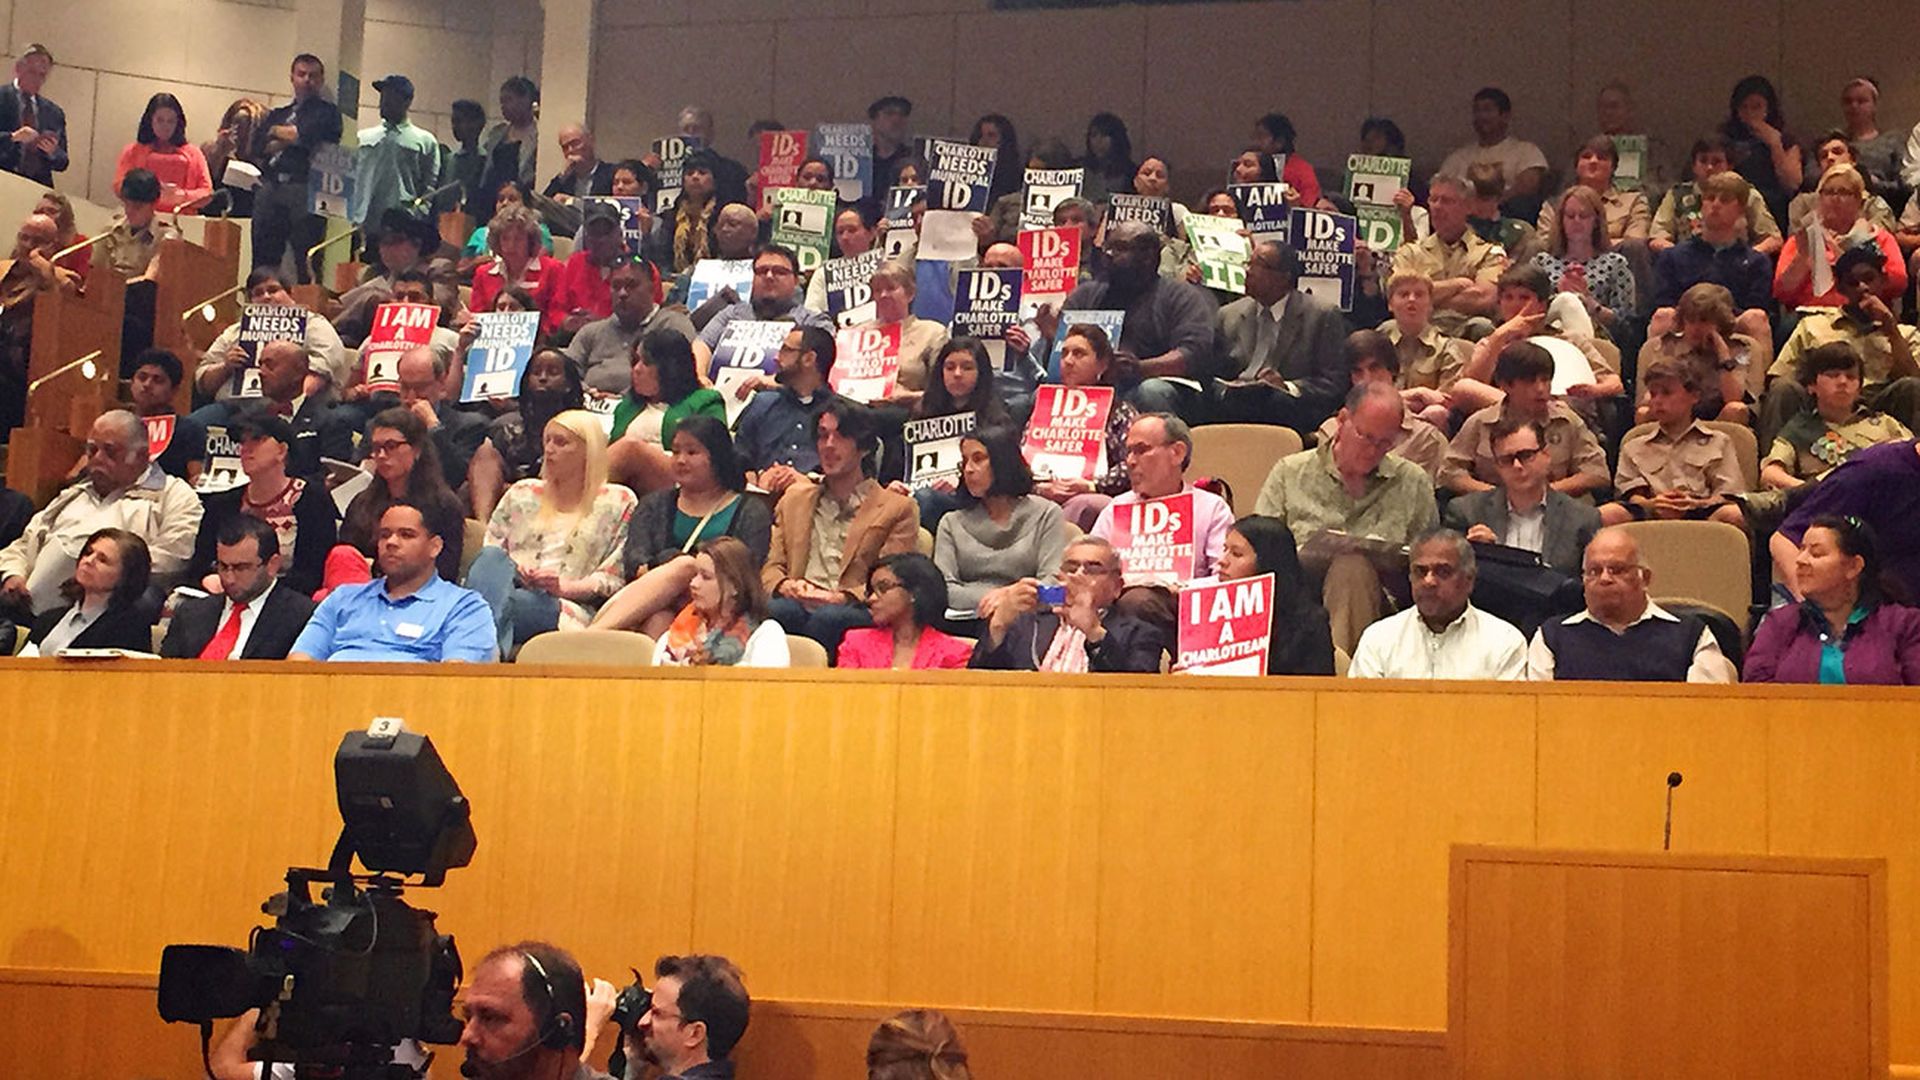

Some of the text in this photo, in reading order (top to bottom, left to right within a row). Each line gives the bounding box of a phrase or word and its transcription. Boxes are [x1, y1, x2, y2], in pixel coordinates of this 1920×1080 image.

[661, 138, 693, 160] IDs
[771, 134, 799, 156] IDs
[825, 135, 866, 147] NEEDS
[935, 142, 995, 162] CHARLOTTE
[834, 155, 858, 178] ID
[939, 155, 988, 175] NEEDS
[1348, 154, 1410, 175] CHARLOTTE
[322, 172, 344, 195] ID
[930, 169, 989, 187] MUNICIPAL
[1024, 169, 1083, 185] CHARLOTTE
[777, 187, 837, 204] CHARLOTTE
[943, 180, 972, 209] ID
[1111, 196, 1168, 211] CHARLOTTE
[1247, 184, 1283, 207] AM
[1114, 207, 1161, 224] NEEDS
[1254, 208, 1264, 220] A
[1304, 211, 1346, 242] IDs
[1358, 219, 1394, 250] D
[1032, 230, 1070, 259] IDs
[1307, 238, 1340, 252] MAKE
[826, 247, 886, 272] CHARLOTTE
[1032, 257, 1063, 269] MAKE
[1304, 262, 1339, 275] SAFER
[832, 261, 878, 283] NEEDS
[1205, 260, 1247, 294] ID
[827, 274, 873, 294] MUNICIP
[968, 271, 1012, 301] IDs
[1030, 279, 1064, 292] SAFER
[843, 284, 873, 310] ID
[970, 300, 1005, 312] MAKE
[244, 304, 307, 319] CHARLOTTE
[380, 307, 431, 330] I AM
[477, 312, 538, 325] CHARLOTTE
[955, 311, 1018, 325] CHARLOTTE
[1063, 311, 1126, 326] CHARLOTTE
[249, 316, 300, 332] NEEDS
[481, 324, 531, 339] NEEDS
[967, 324, 1002, 337] SAFER
[240, 330, 305, 344] MUNICIPAL
[394, 329, 405, 340] A
[852, 330, 891, 352] IDs
[484, 348, 516, 373] ID
[730, 345, 765, 368] ID
[848, 365, 883, 378] SAFER
[1051, 388, 1098, 418] IDs
[148, 420, 167, 443] M
[904, 413, 976, 443] CHARLOTTE
[1050, 416, 1087, 429] MAKE
[1032, 426, 1102, 442] CHARLOTTE
[1044, 439, 1084, 454] SAFER
[1130, 501, 1181, 536] IDs
[1132, 531, 1175, 547] MAKE
[1128, 557, 1173, 571] SAFER
[1190, 580, 1264, 625] I AM
[1218, 621, 1235, 645] A
[1180, 635, 1268, 666] CHARLOTTEAN
[379, 720, 391, 732] 3
